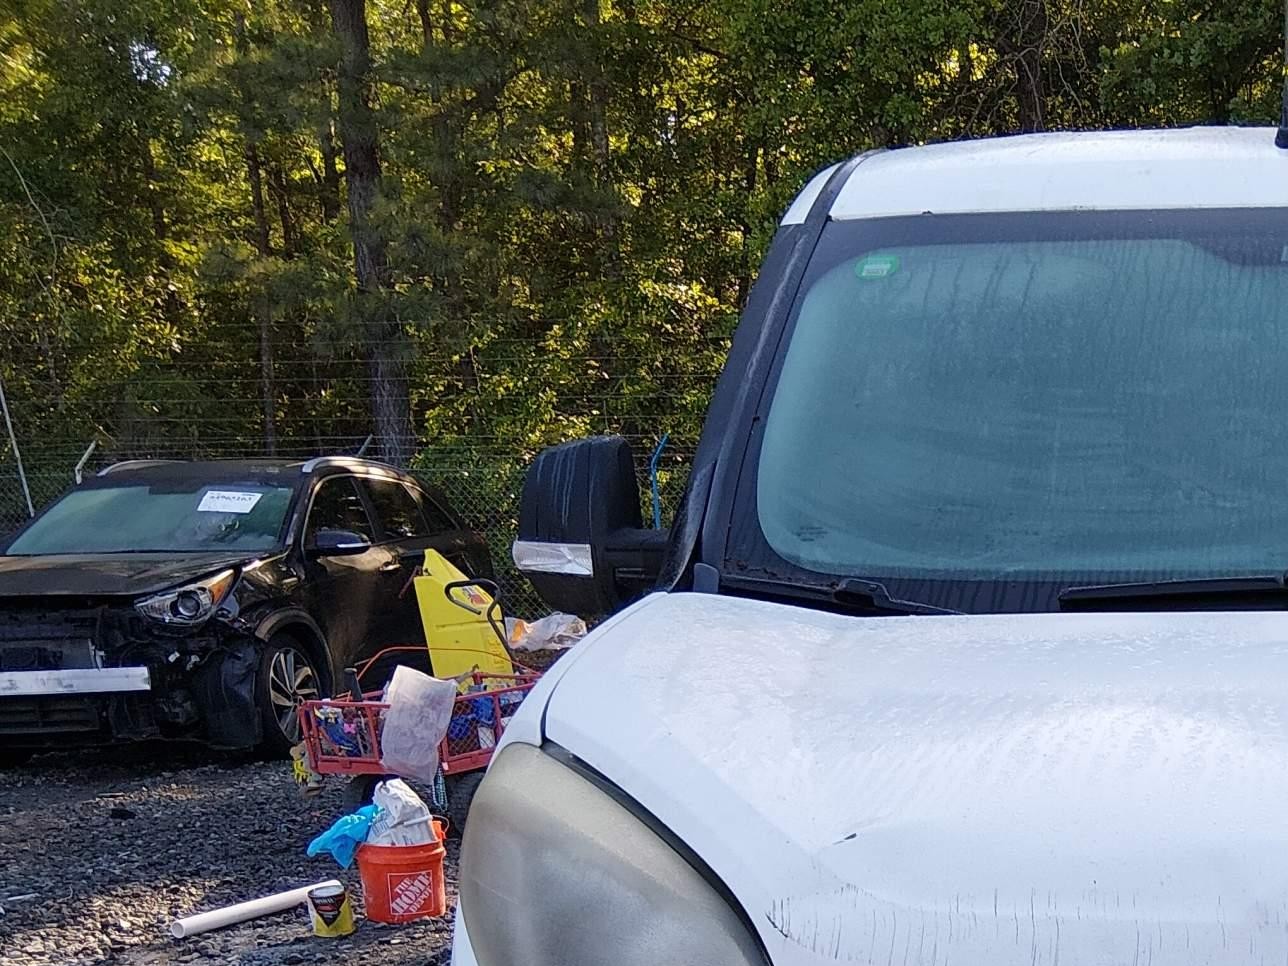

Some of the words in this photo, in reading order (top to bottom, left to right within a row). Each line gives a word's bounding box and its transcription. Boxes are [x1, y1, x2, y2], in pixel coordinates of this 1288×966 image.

[391, 872, 432, 914] HOME
[394, 877, 414, 895] THE
[408, 887, 433, 913] DEPOT
